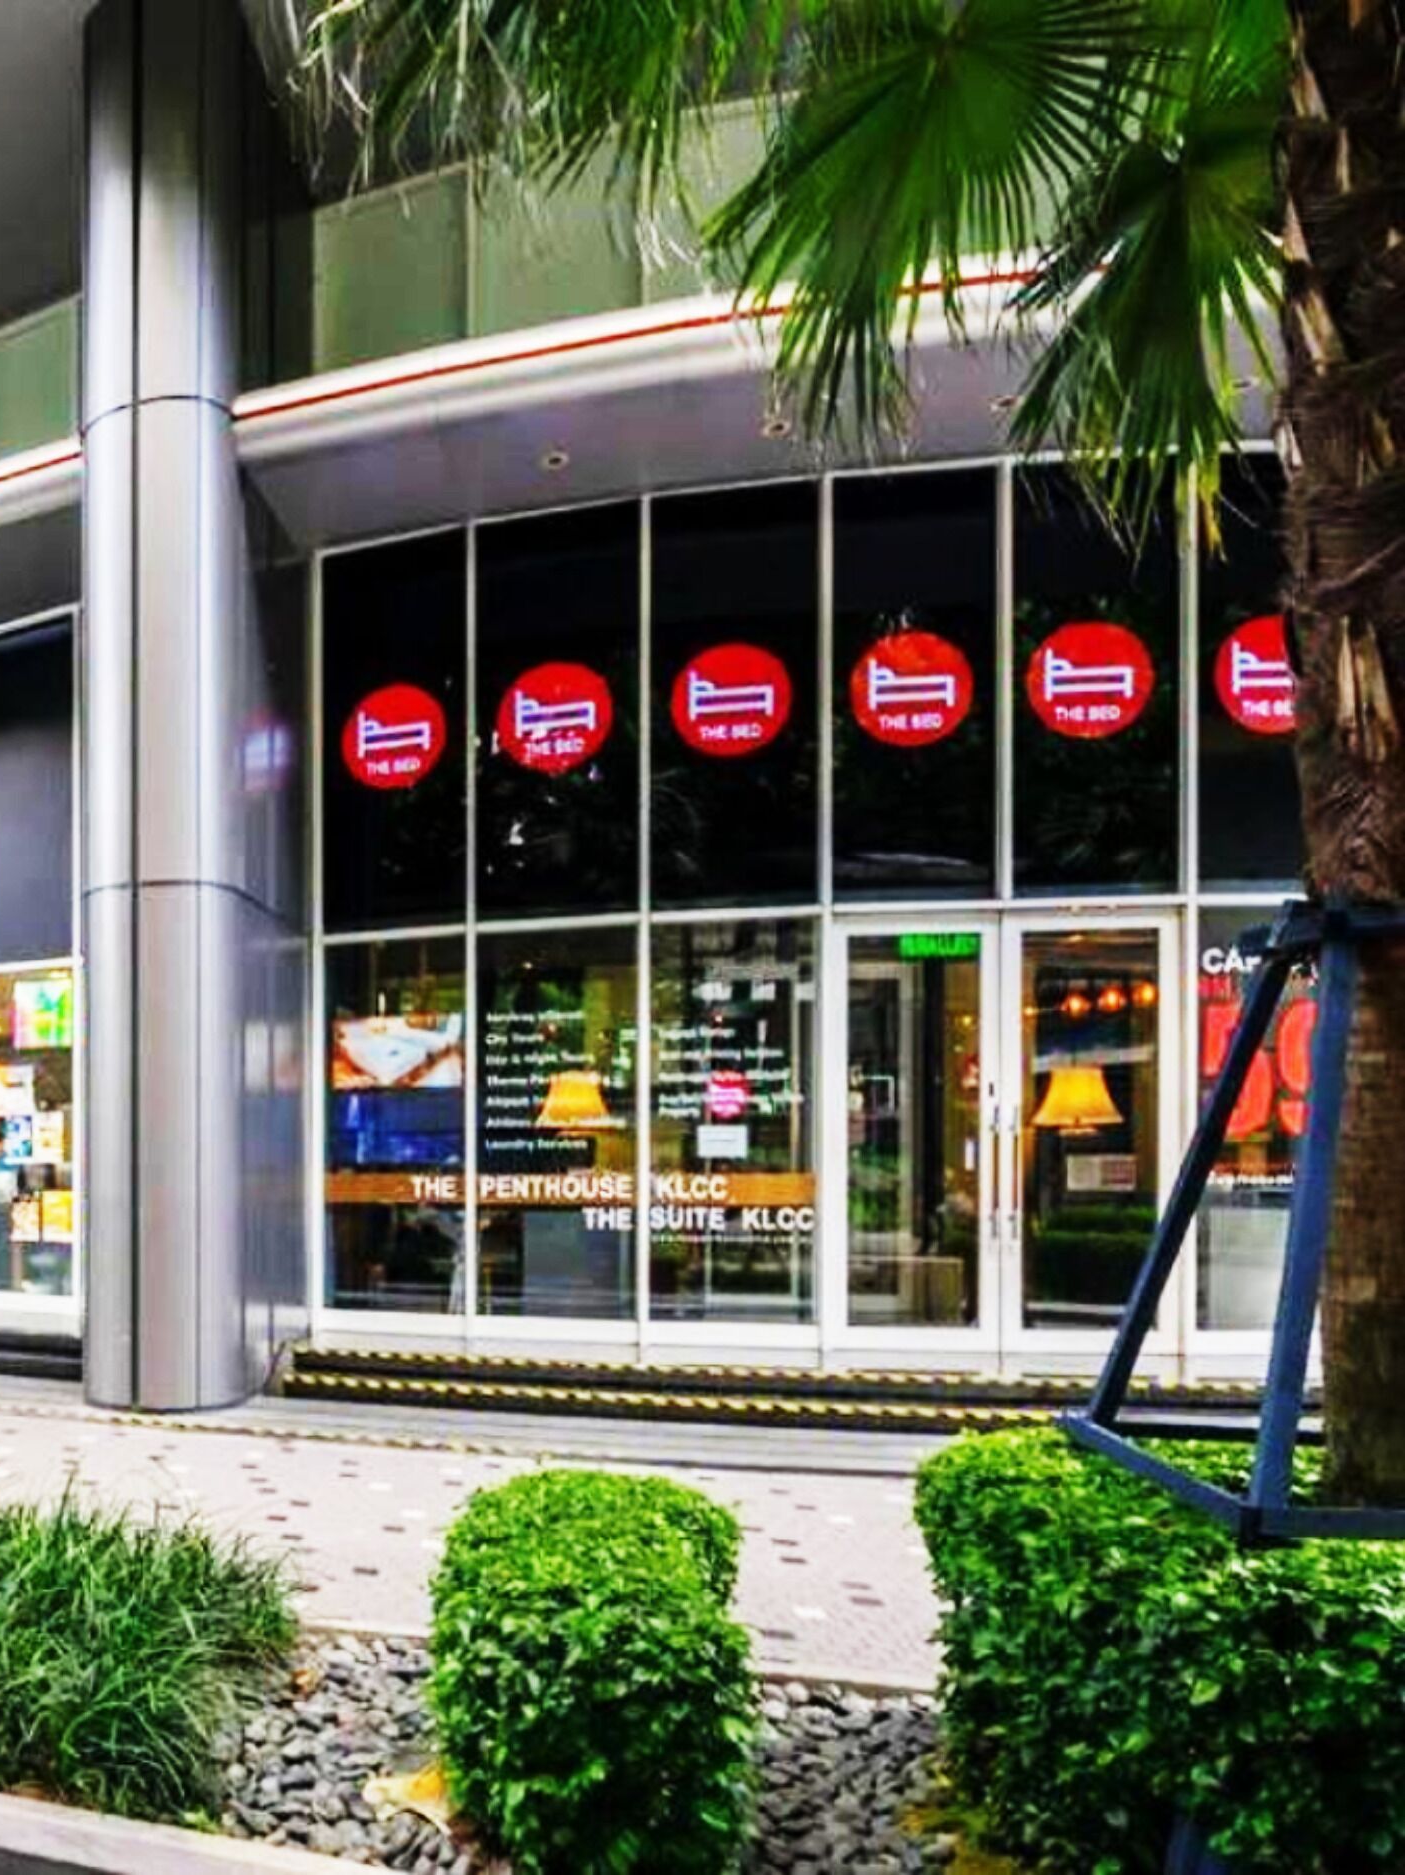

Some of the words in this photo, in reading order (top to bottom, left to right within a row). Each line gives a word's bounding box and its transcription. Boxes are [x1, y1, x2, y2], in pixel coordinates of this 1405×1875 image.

[1055, 704, 1086, 722] THE
[1088, 703, 1122, 721] BED
[1241, 699, 1270, 717] THE
[1272, 697, 1294, 716] BE
[698, 724, 728, 741] THE
[731, 721, 763, 740] BED
[878, 713, 907, 731] THE
[911, 711, 945, 730] BED
[555, 736, 586, 755] BED
[365, 759, 391, 777] THE
[393, 756, 422, 774] BED
[410, 1173, 458, 1200] THE
[480, 1172, 633, 1200] PENTHOUSE
[656, 1173, 729, 1200] KLCC
[582, 1206, 634, 1232] THE
[648, 1206, 726, 1232] SUITE
[741, 1206, 816, 1232] KLCC
